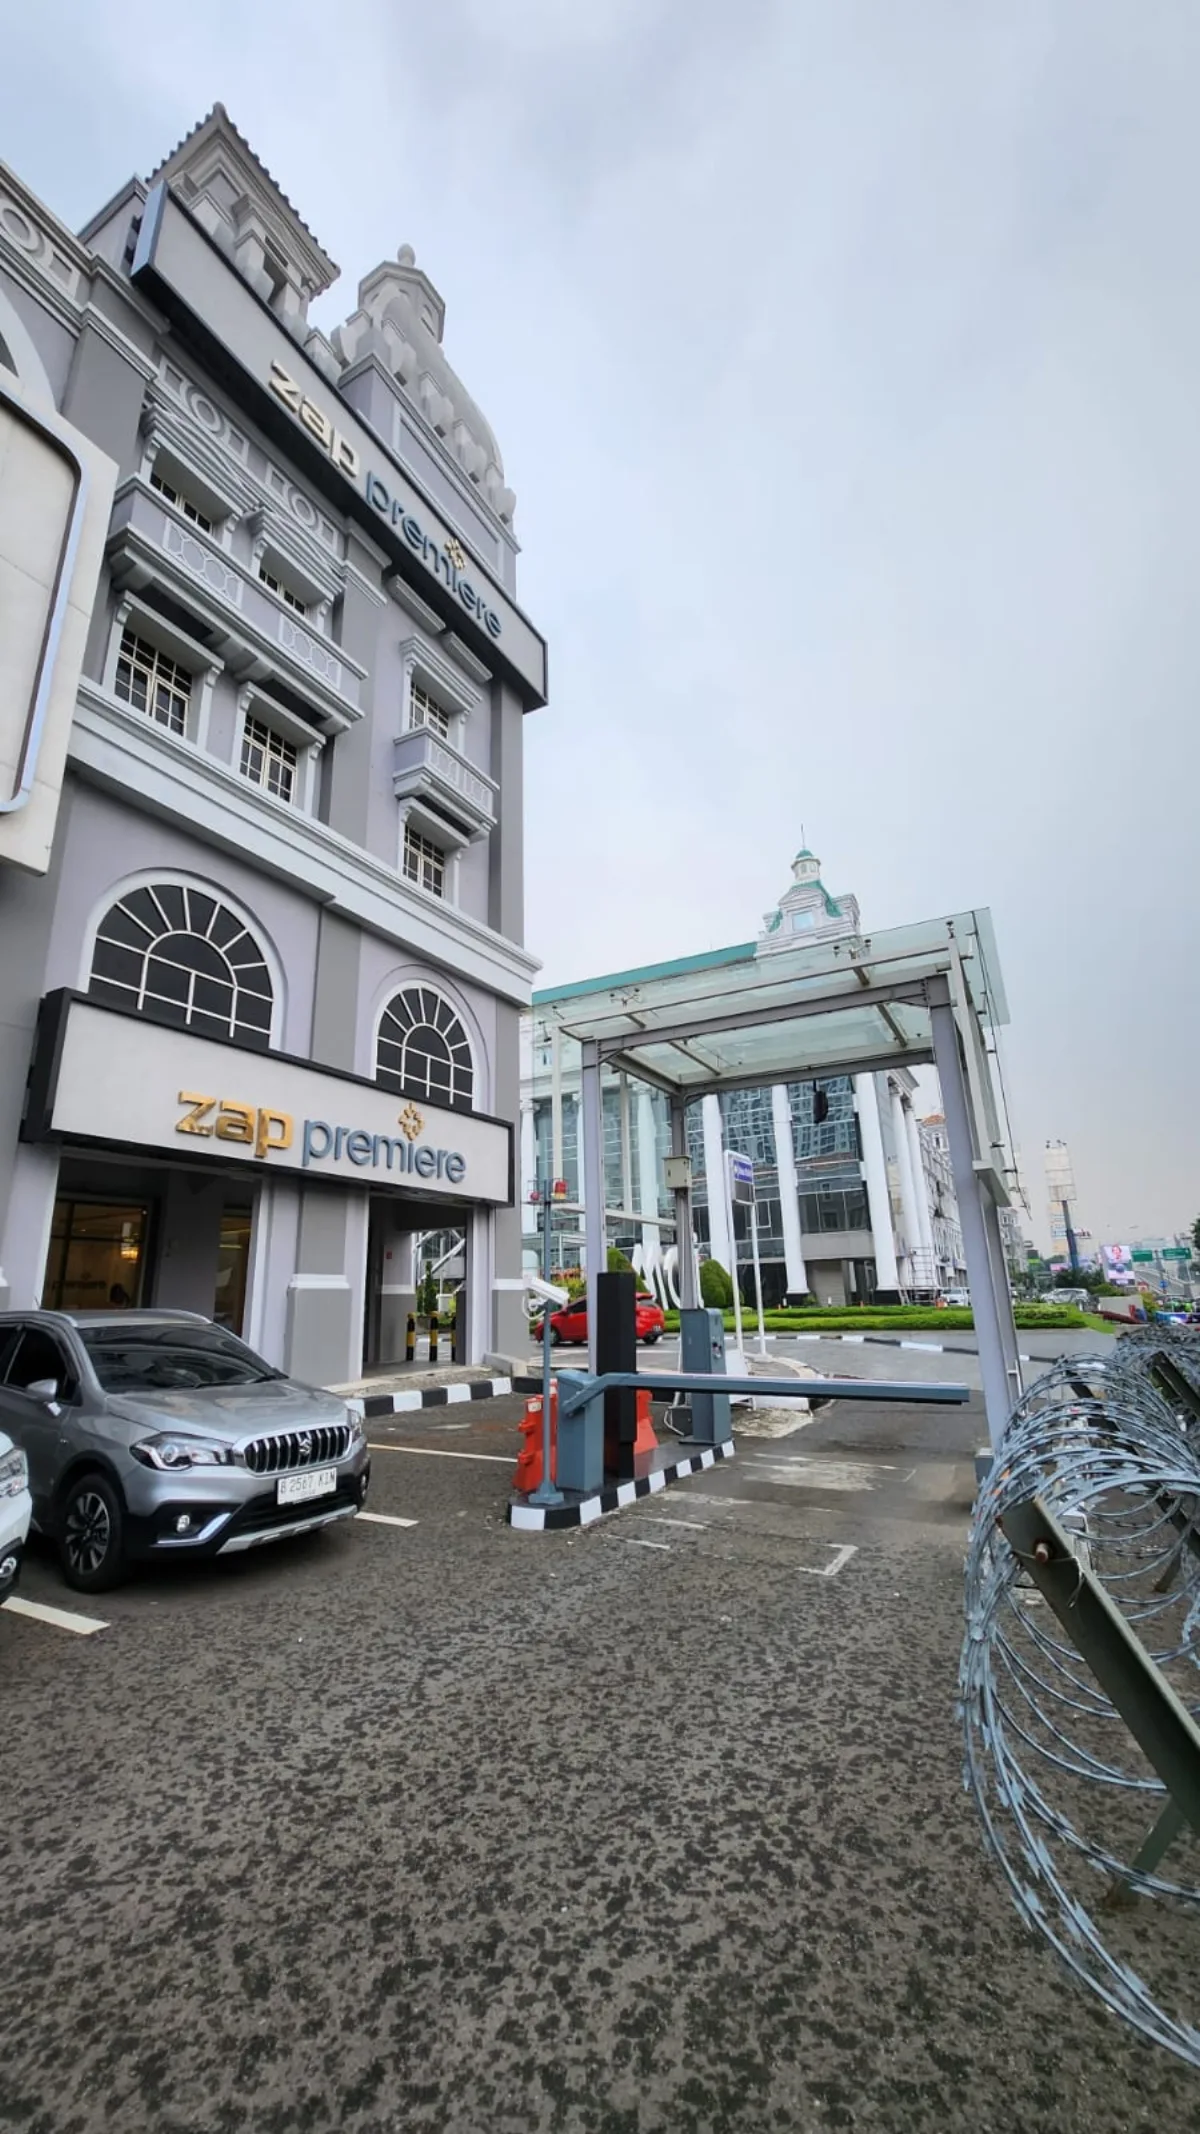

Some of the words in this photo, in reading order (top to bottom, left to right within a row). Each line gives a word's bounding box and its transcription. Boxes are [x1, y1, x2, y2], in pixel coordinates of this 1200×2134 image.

[268, 360, 361, 479] zap
[365, 470, 502, 640] premiere
[175, 1090, 293, 1159] zap
[302, 1102, 467, 1184] premiere
